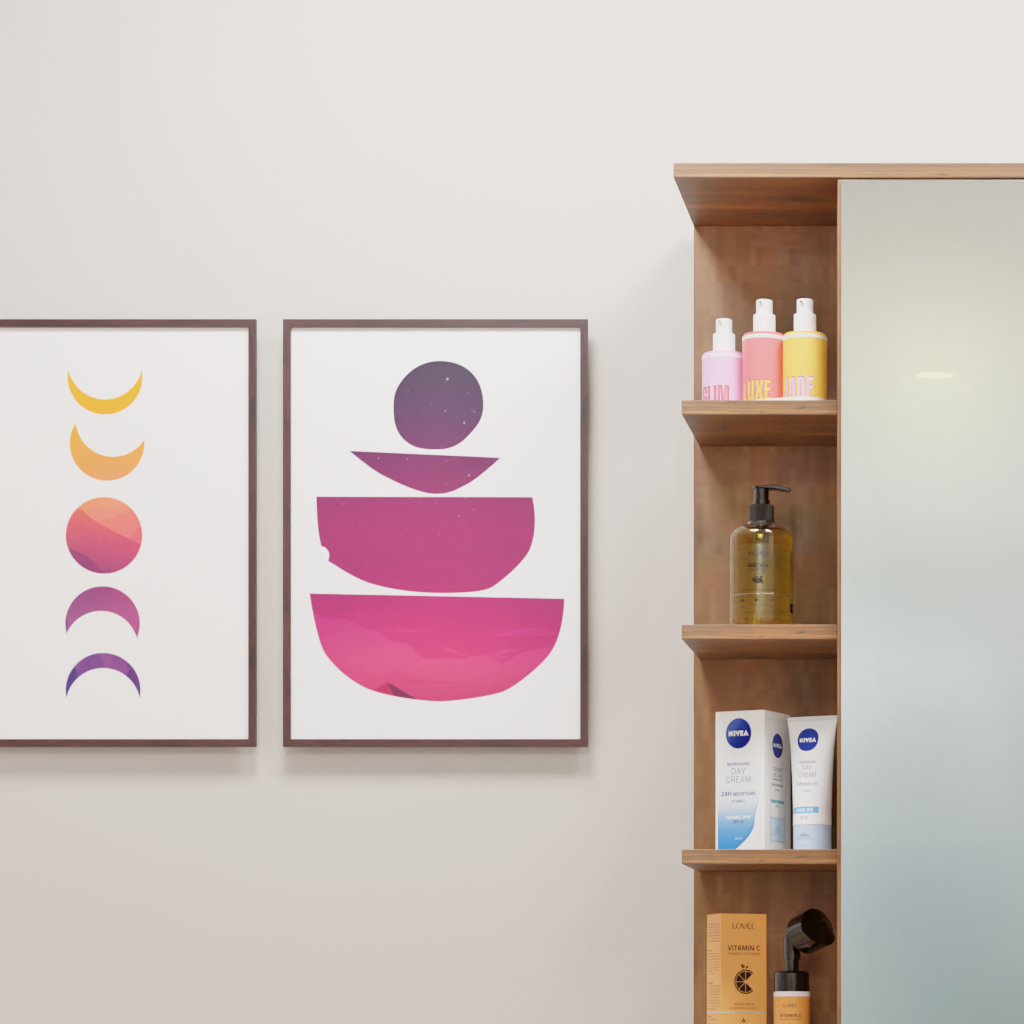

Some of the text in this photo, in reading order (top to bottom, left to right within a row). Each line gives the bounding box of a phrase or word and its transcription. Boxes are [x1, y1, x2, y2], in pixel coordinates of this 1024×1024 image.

[743, 379, 772, 400] LUXE
[783, 376, 815, 397] JADE
[731, 767, 746, 775] DAY
[725, 776, 752, 784] CREAM
